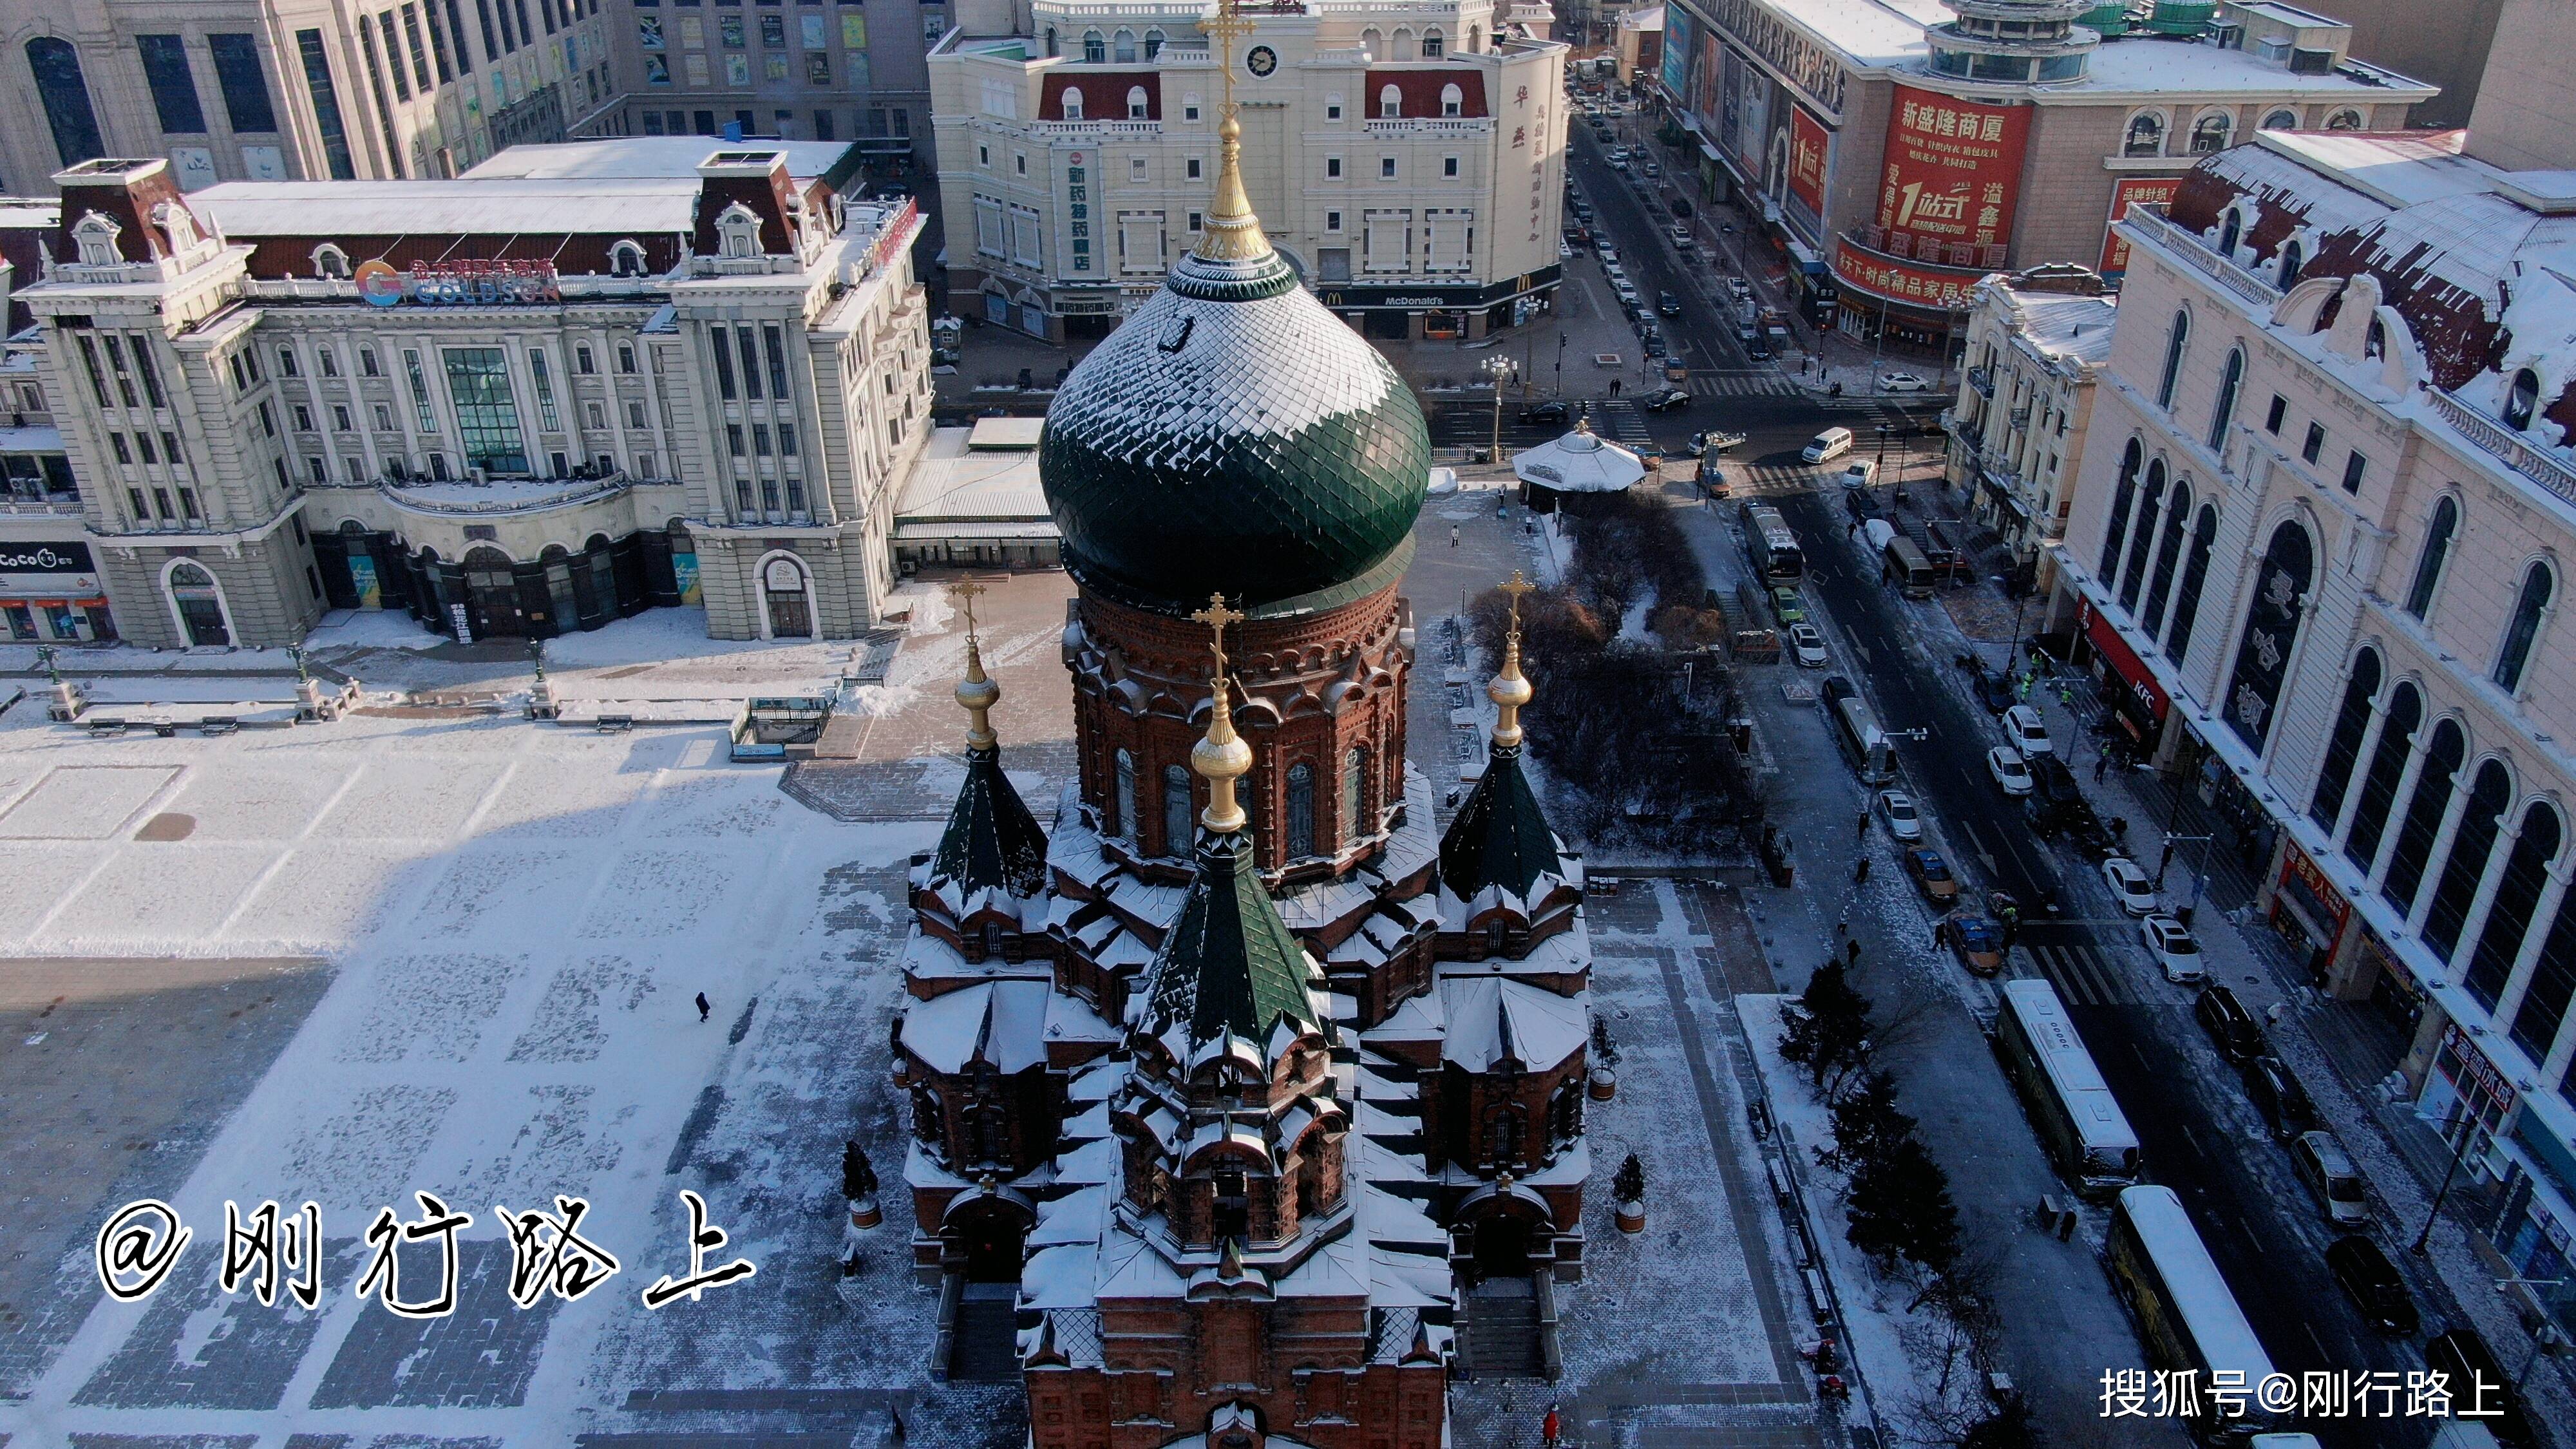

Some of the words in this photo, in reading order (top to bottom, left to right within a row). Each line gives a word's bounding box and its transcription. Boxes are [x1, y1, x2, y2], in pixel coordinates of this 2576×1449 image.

[1901, 99, 2005, 143] 新盛隆商厦
[1900, 133, 1924, 148] 日用百货
[1927, 140, 1960, 154] 针织内衣
[1963, 146, 1999, 158] 箱包皮具
[1942, 156, 1978, 170] 共同打造
[1880, 163, 1899, 231] 爱得福
[1897, 181, 1971, 226] 1站式
[2123, 187, 2168, 200] 品牌针织
[1975, 182, 2003, 248] 溢鑫源
[1866, 224, 2008, 269] 新盛隆商厦
[415, 283, 560, 304] GOLDSUN
[1385, 296, 1444, 306] McDonald's
[0, 554, 37, 567] CoCo
[2134, 680, 2155, 709] KFC
[2455, 1035, 2512, 1108] 蜜雪冰城
